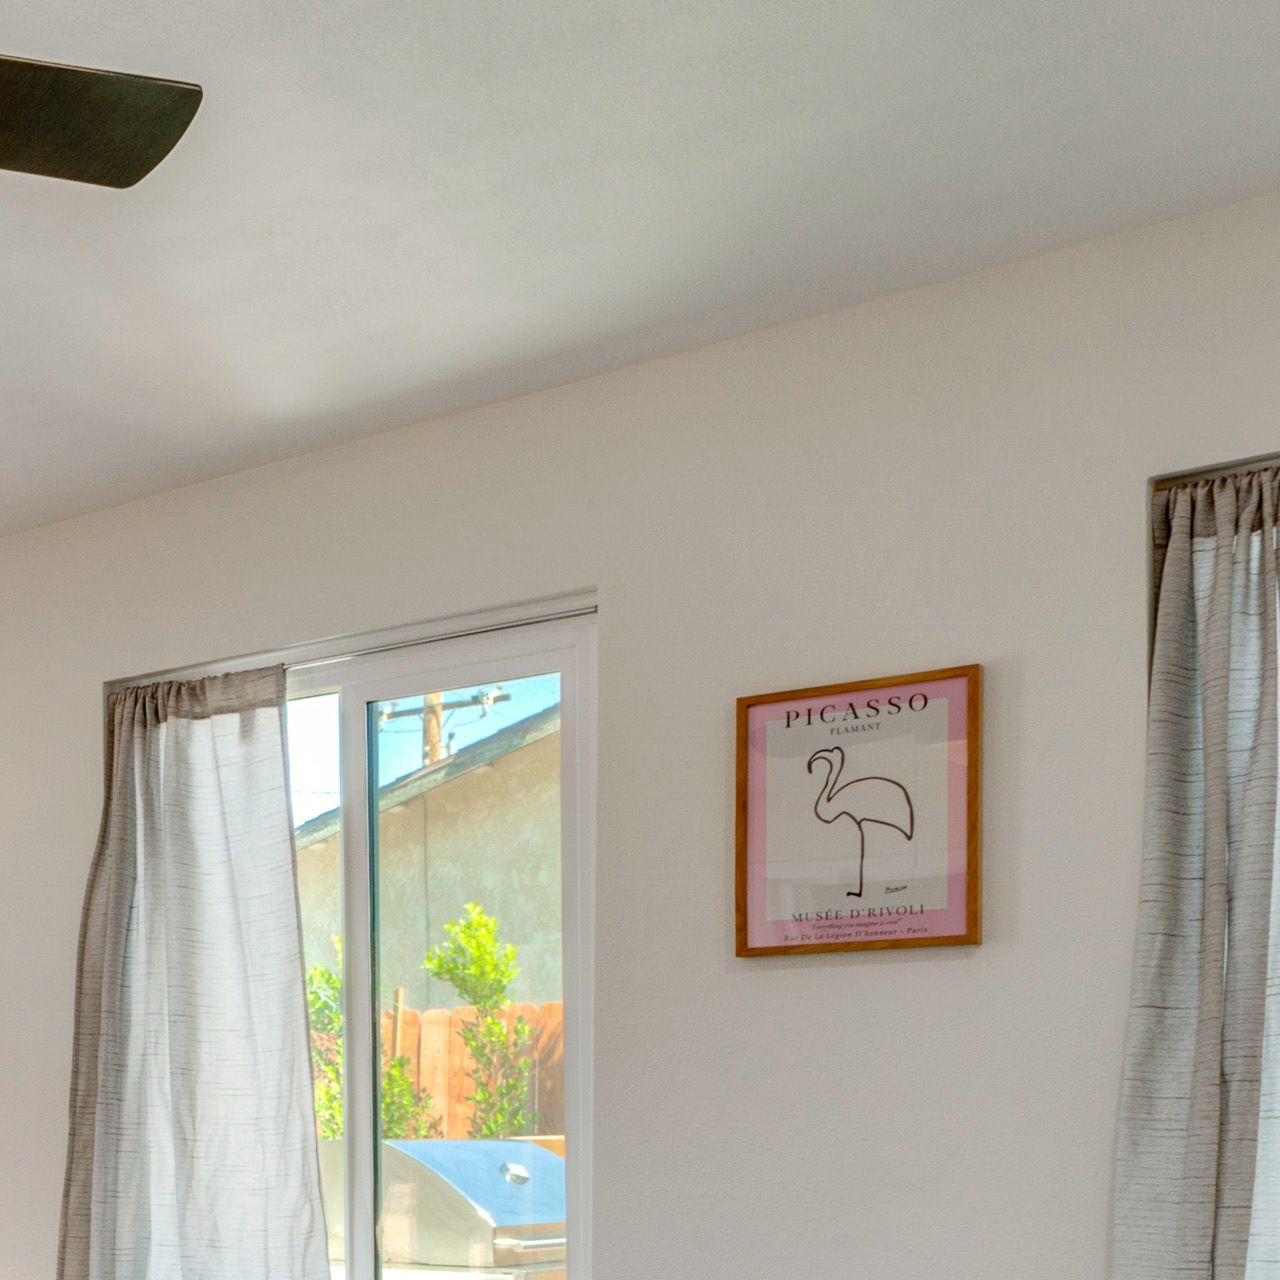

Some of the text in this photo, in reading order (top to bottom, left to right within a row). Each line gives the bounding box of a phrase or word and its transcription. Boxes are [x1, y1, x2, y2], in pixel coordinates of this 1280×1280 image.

[785, 692, 929, 729] PICASSO
[830, 722, 881, 736] FLAMANT
[792, 903, 925, 923] MUSÉE D'RIVOLI
